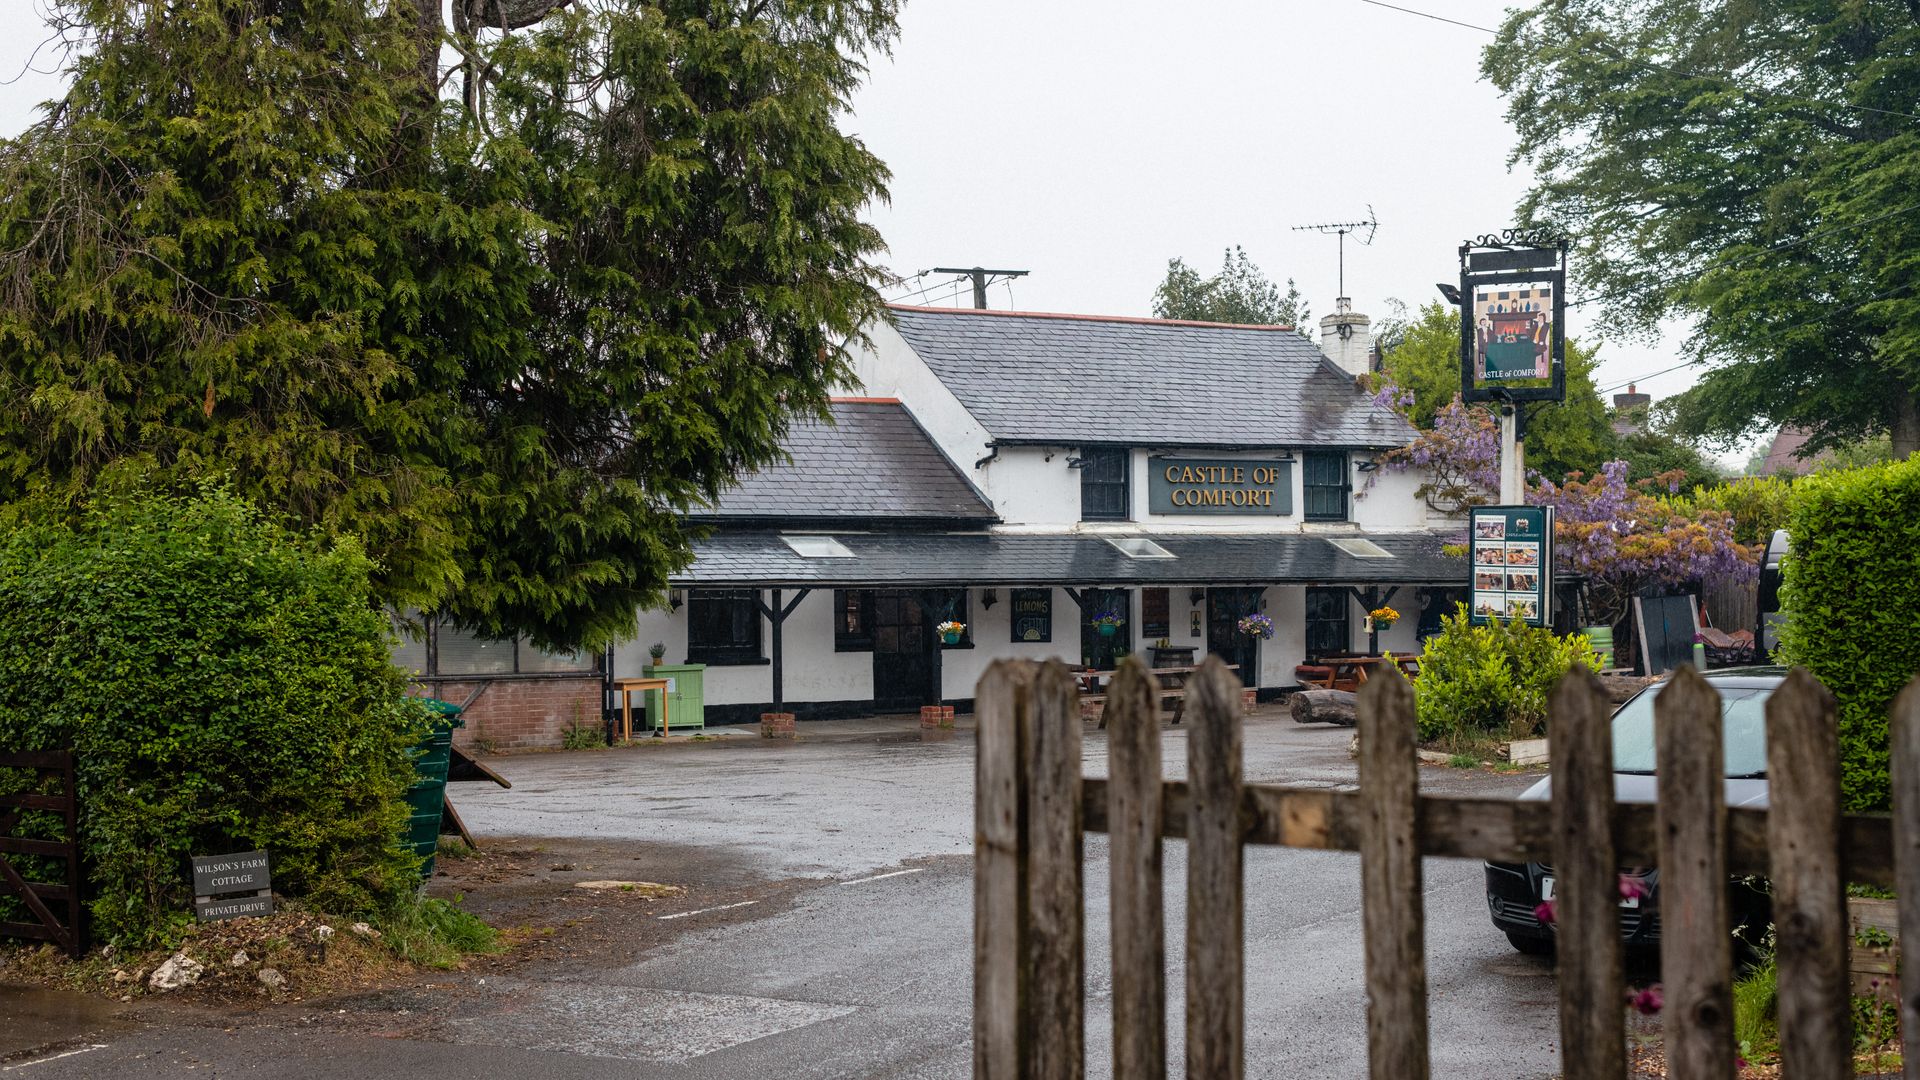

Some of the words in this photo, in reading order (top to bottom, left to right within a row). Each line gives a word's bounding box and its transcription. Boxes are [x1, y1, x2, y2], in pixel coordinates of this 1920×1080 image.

[1165, 465, 1245, 483] CASTLE
[1252, 467, 1280, 484] OF
[1171, 489, 1274, 506] COMFORT
[1015, 600, 1048, 613] LEMONS
[196, 862, 239, 874] WILSON'S
[242, 858, 266, 869] FARM
[212, 874, 253, 886] COTTAGE
[204, 905, 238, 916] PRIVATE
[240, 902, 266, 912] DRIVE
